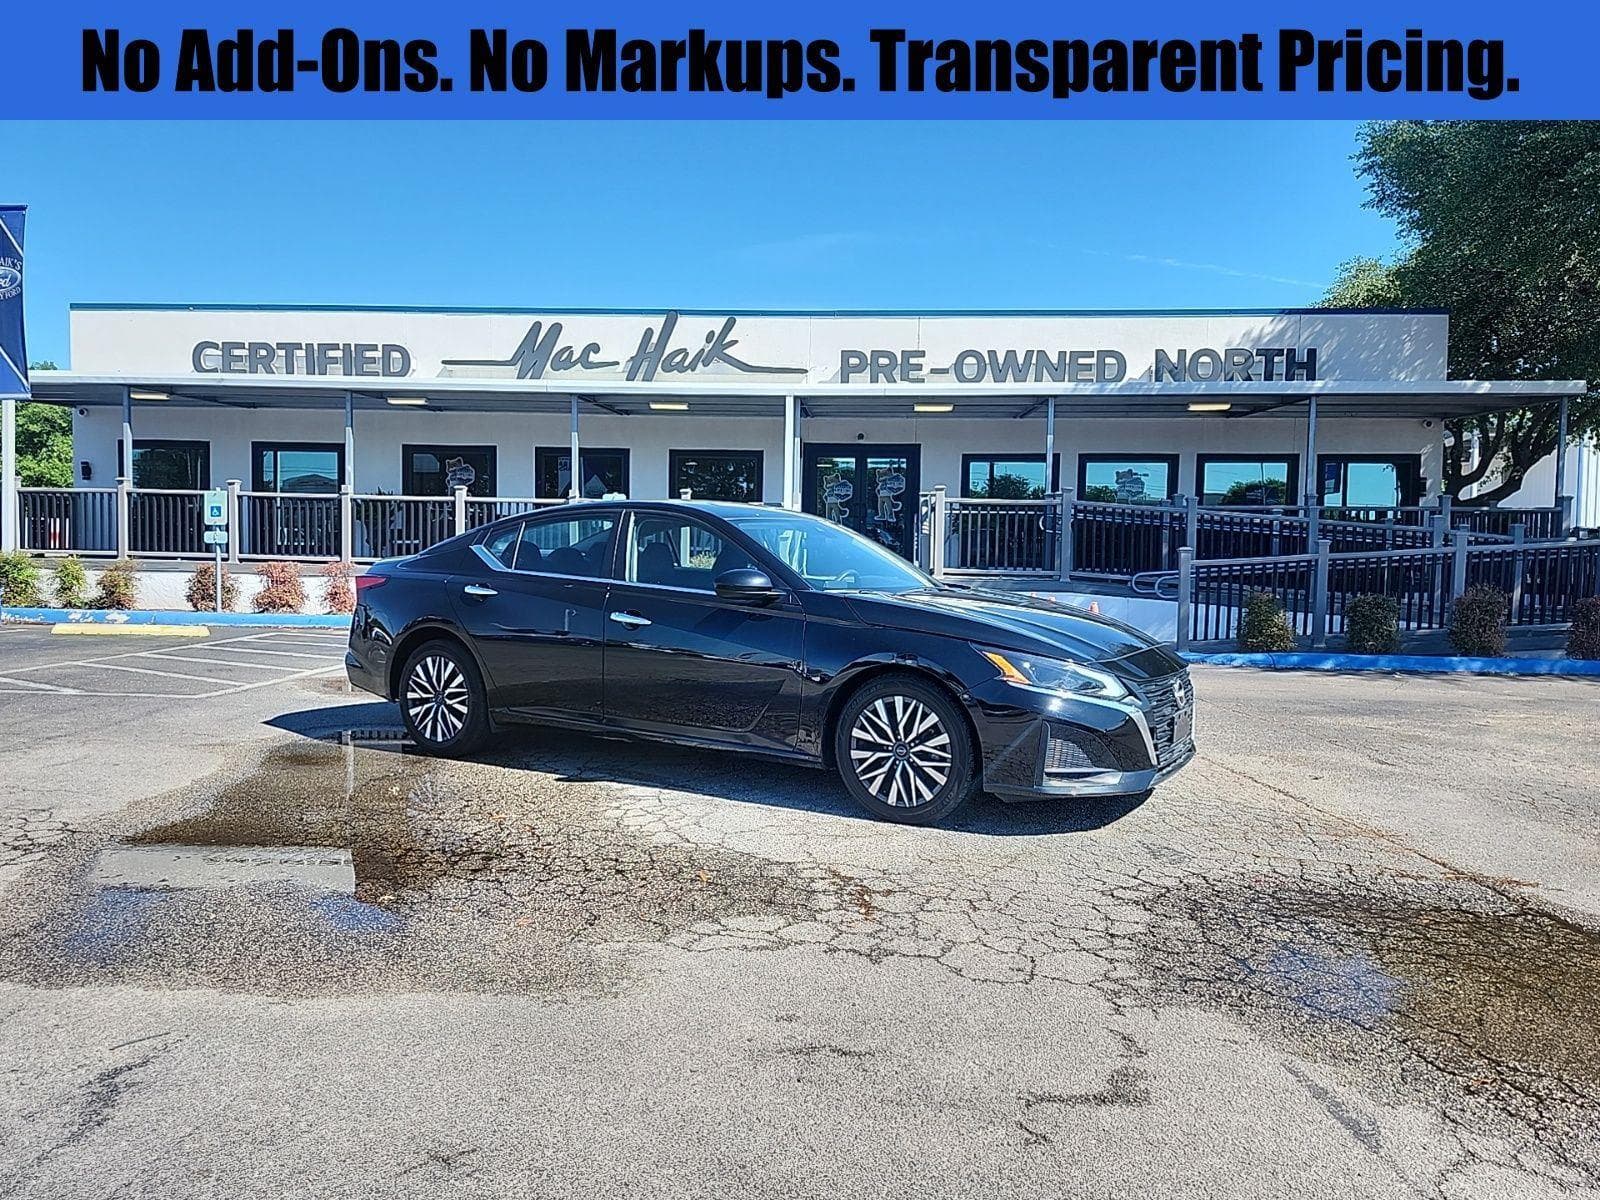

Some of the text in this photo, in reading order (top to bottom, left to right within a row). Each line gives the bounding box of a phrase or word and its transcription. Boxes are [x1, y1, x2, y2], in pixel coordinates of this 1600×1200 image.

[192, 340, 411, 377] CERTIFIED
[441, 310, 808, 382] Mac Haik
[840, 348, 1318, 383] PRE-OWNED NORTH
